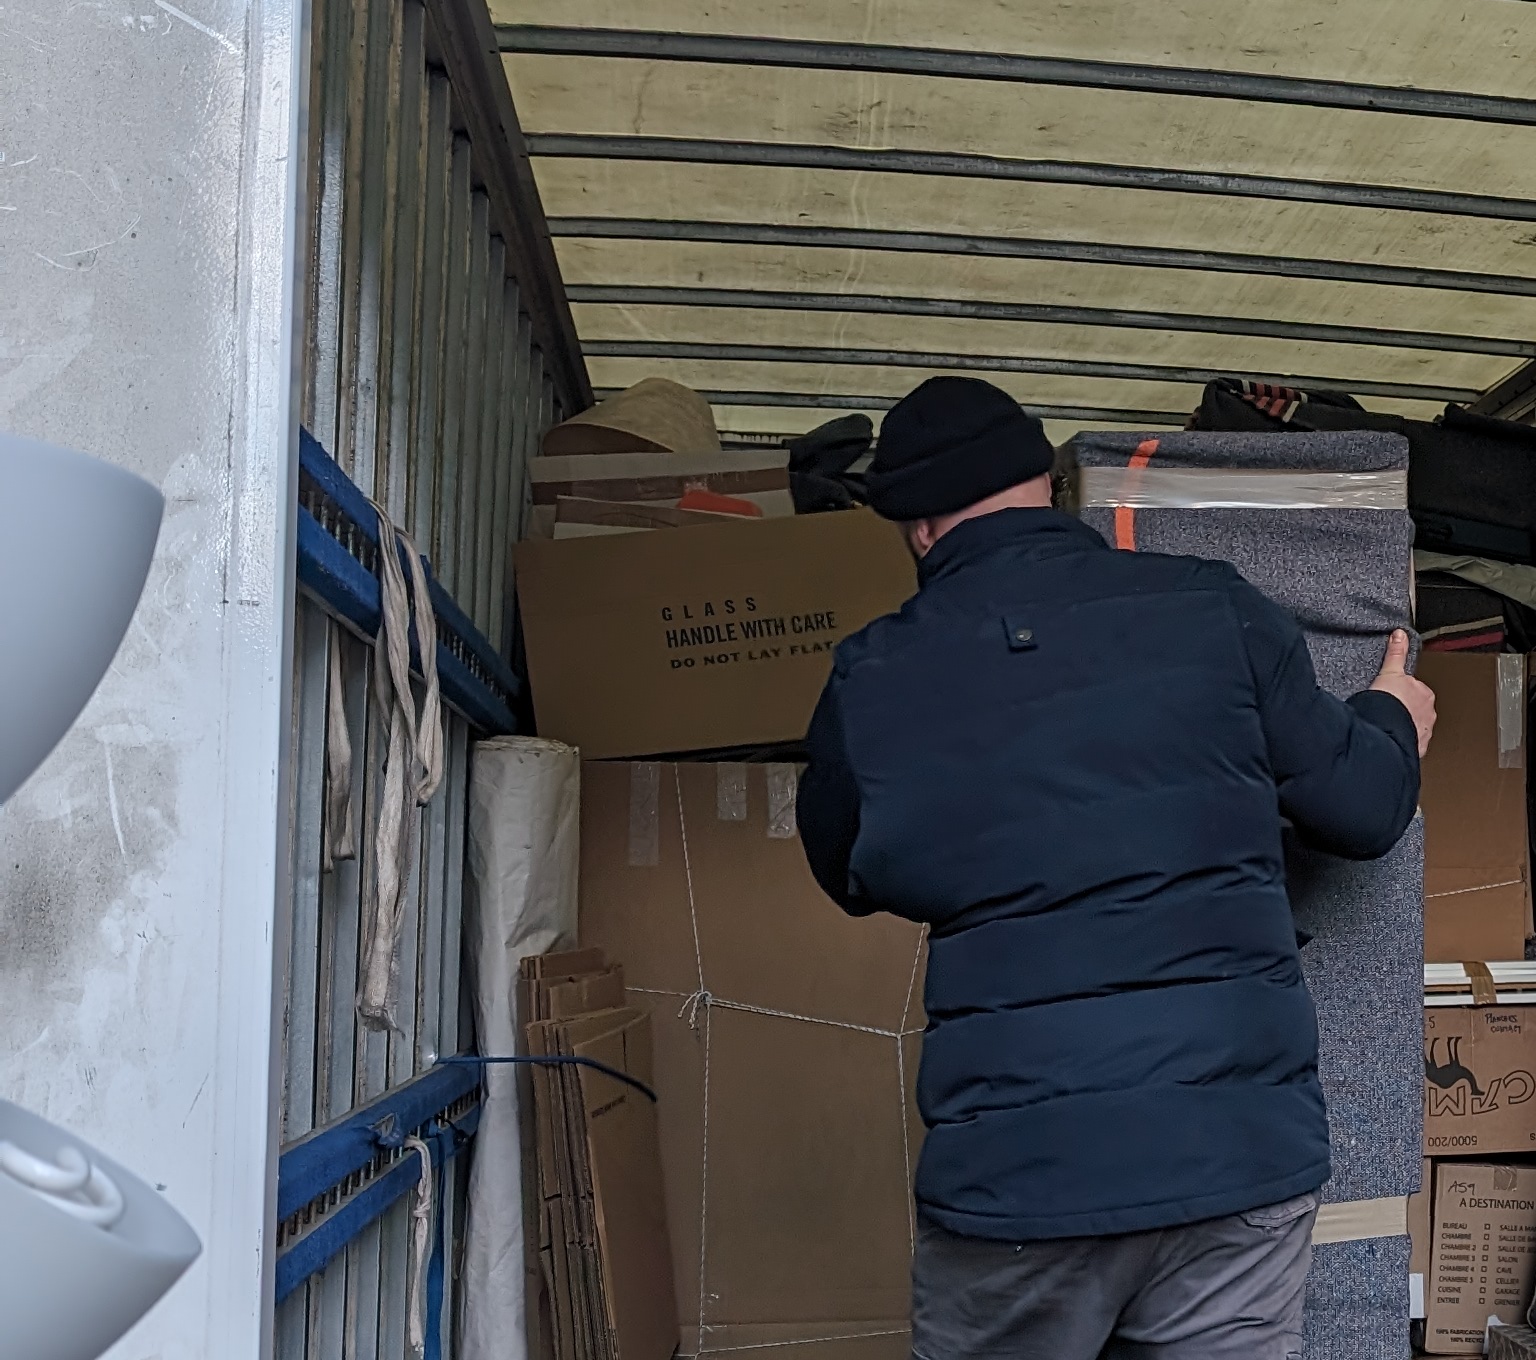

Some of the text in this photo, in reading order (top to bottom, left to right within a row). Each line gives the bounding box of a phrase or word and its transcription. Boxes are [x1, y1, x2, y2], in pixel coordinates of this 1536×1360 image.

[661, 596, 758, 622] GLASS
[665, 611, 837, 649] HANDLE WITH CARE
[670, 641, 835, 670] DO NOT LAY FLAT
[1427, 1134, 1478, 1147] 5000/200
[1459, 1198, 1467, 1209] A
[1468, 1197, 1535, 1211] DESTINATION
[1442, 1222, 1468, 1230] BUREAU
